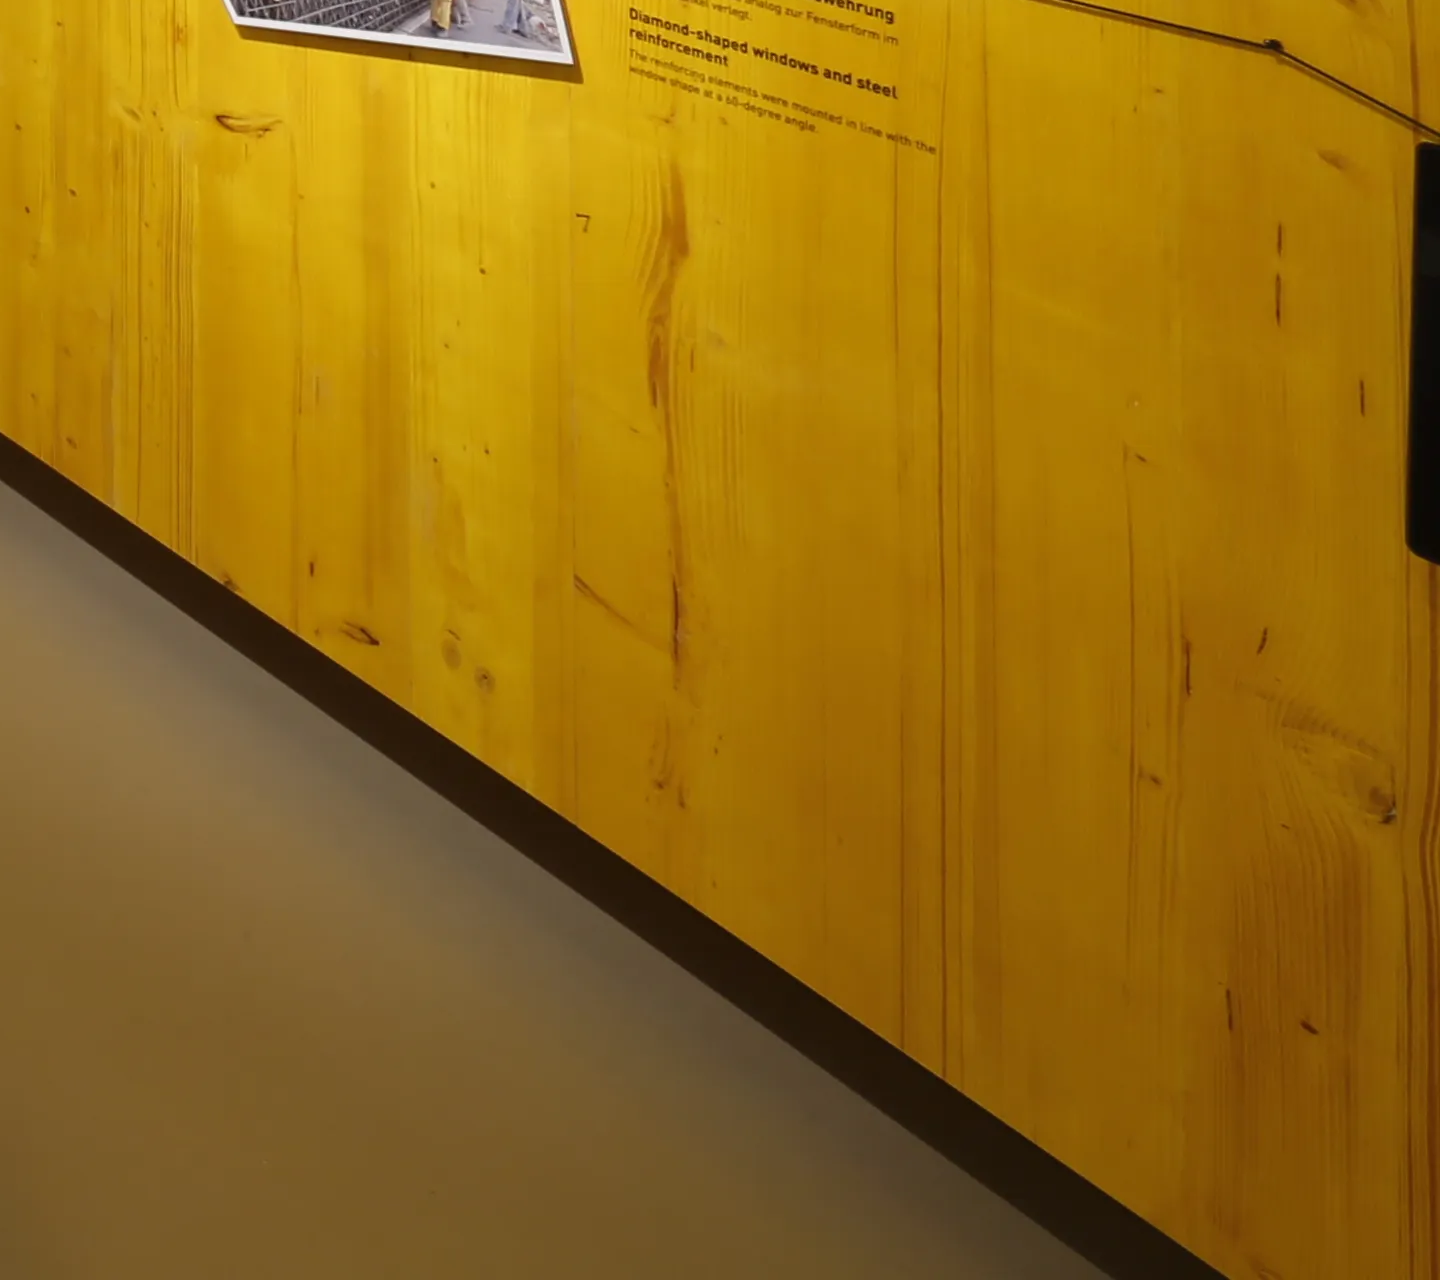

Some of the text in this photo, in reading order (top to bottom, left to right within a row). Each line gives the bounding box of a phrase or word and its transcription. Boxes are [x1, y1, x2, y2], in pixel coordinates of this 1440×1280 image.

[711, 2, 753, 22] verlegt.
[784, 8, 804, 19] zur
[806, 11, 880, 40] Fensterform
[882, 32, 899, 47] im
[629, 28, 730, 68] reinforcement
[629, 7, 900, 101] Diamond-shaped windows and steel
[628, 48, 937, 156] The reinforcing elements were mounted in line with the
[629, 65, 819, 133] window shape at a 60-degree angle.
